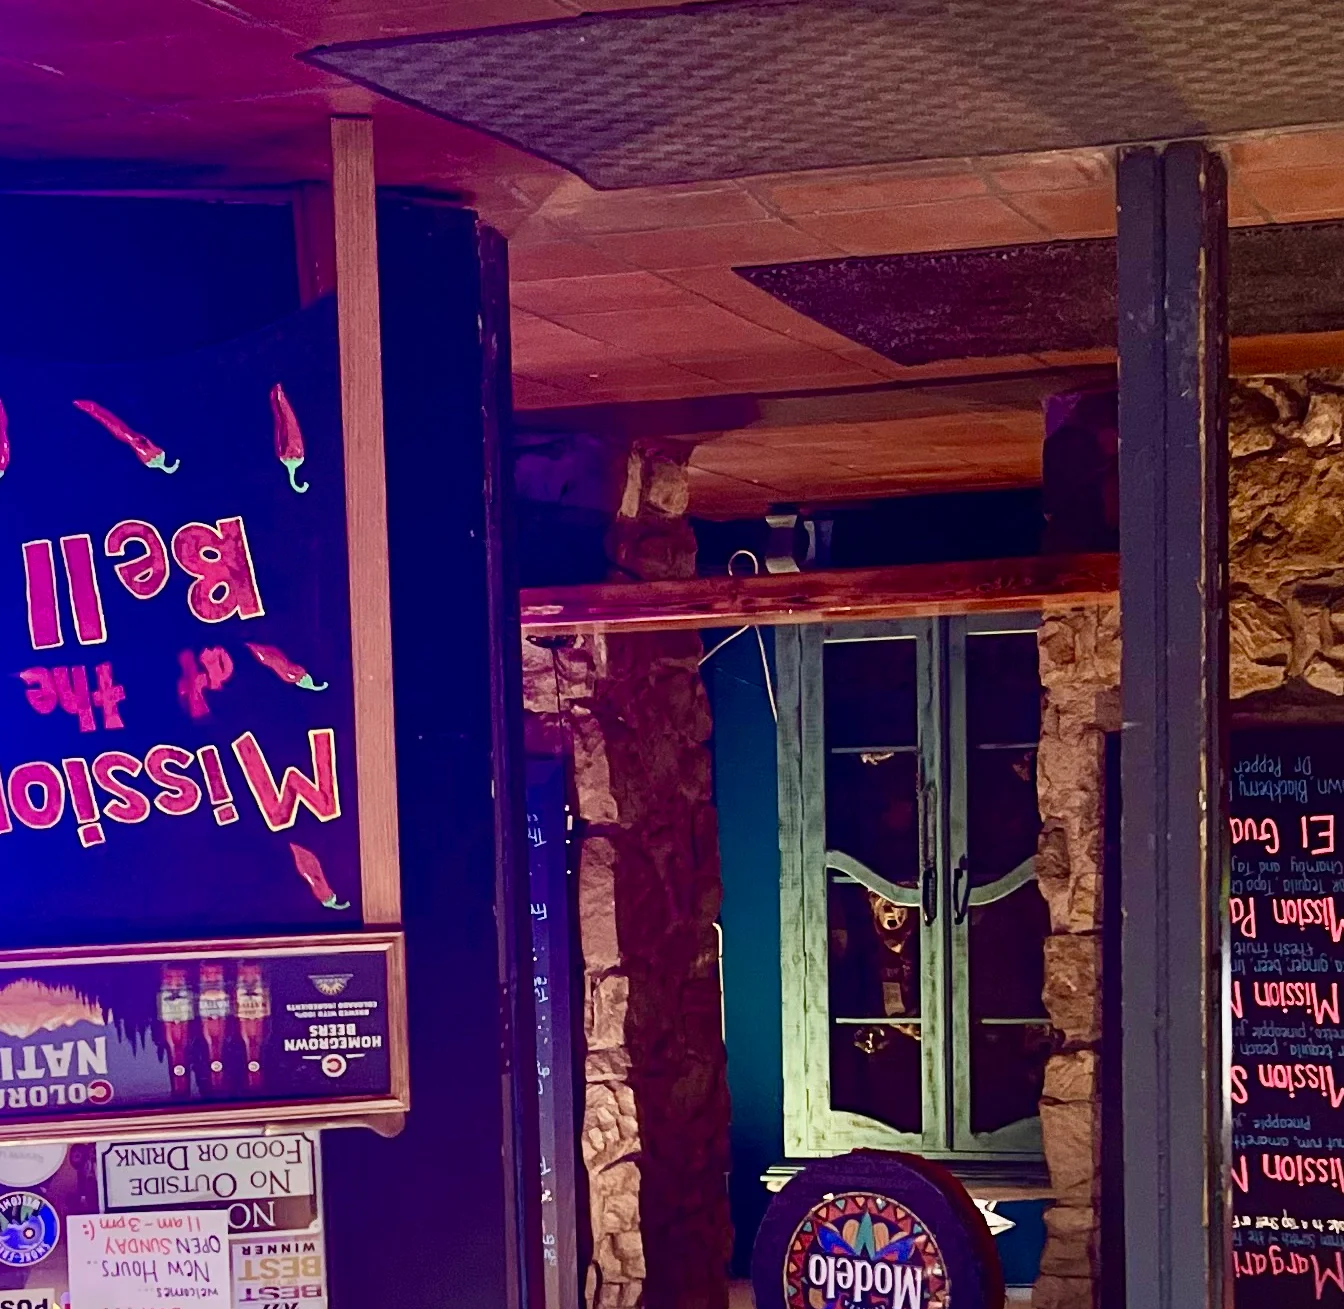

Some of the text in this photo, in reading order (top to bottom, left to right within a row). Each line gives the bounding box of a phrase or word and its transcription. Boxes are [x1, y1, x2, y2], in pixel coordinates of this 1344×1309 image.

[18, 645, 235, 734] at the
[1233, 754, 1312, 778] Dr Pepper
[1238, 770, 1309, 804] Blackberry
[1299, 814, 1336, 855] El
[1258, 861, 1281, 876] and
[1252, 981, 1340, 1025] Mission
[308, 1023, 356, 1039] BEERS
[283, 1035, 382, 1052] HOMEGROWN
[1239, 1038, 1279, 1057] peach
[236, 1139, 302, 1164] FOOD
[1232, 1134, 1289, 1151] amarett
[113, 1147, 189, 1172] DRINK
[228, 1201, 275, 1229] NO
[103, 1233, 221, 1256] OPEN SUNDAY
[240, 1241, 315, 1255] WINNER
[1319, 1235, 1344, 1252] from
[167, 1260, 210, 1283] New
[238, 1254, 321, 1281] BEST
[238, 1284, 322, 1302] BEST
